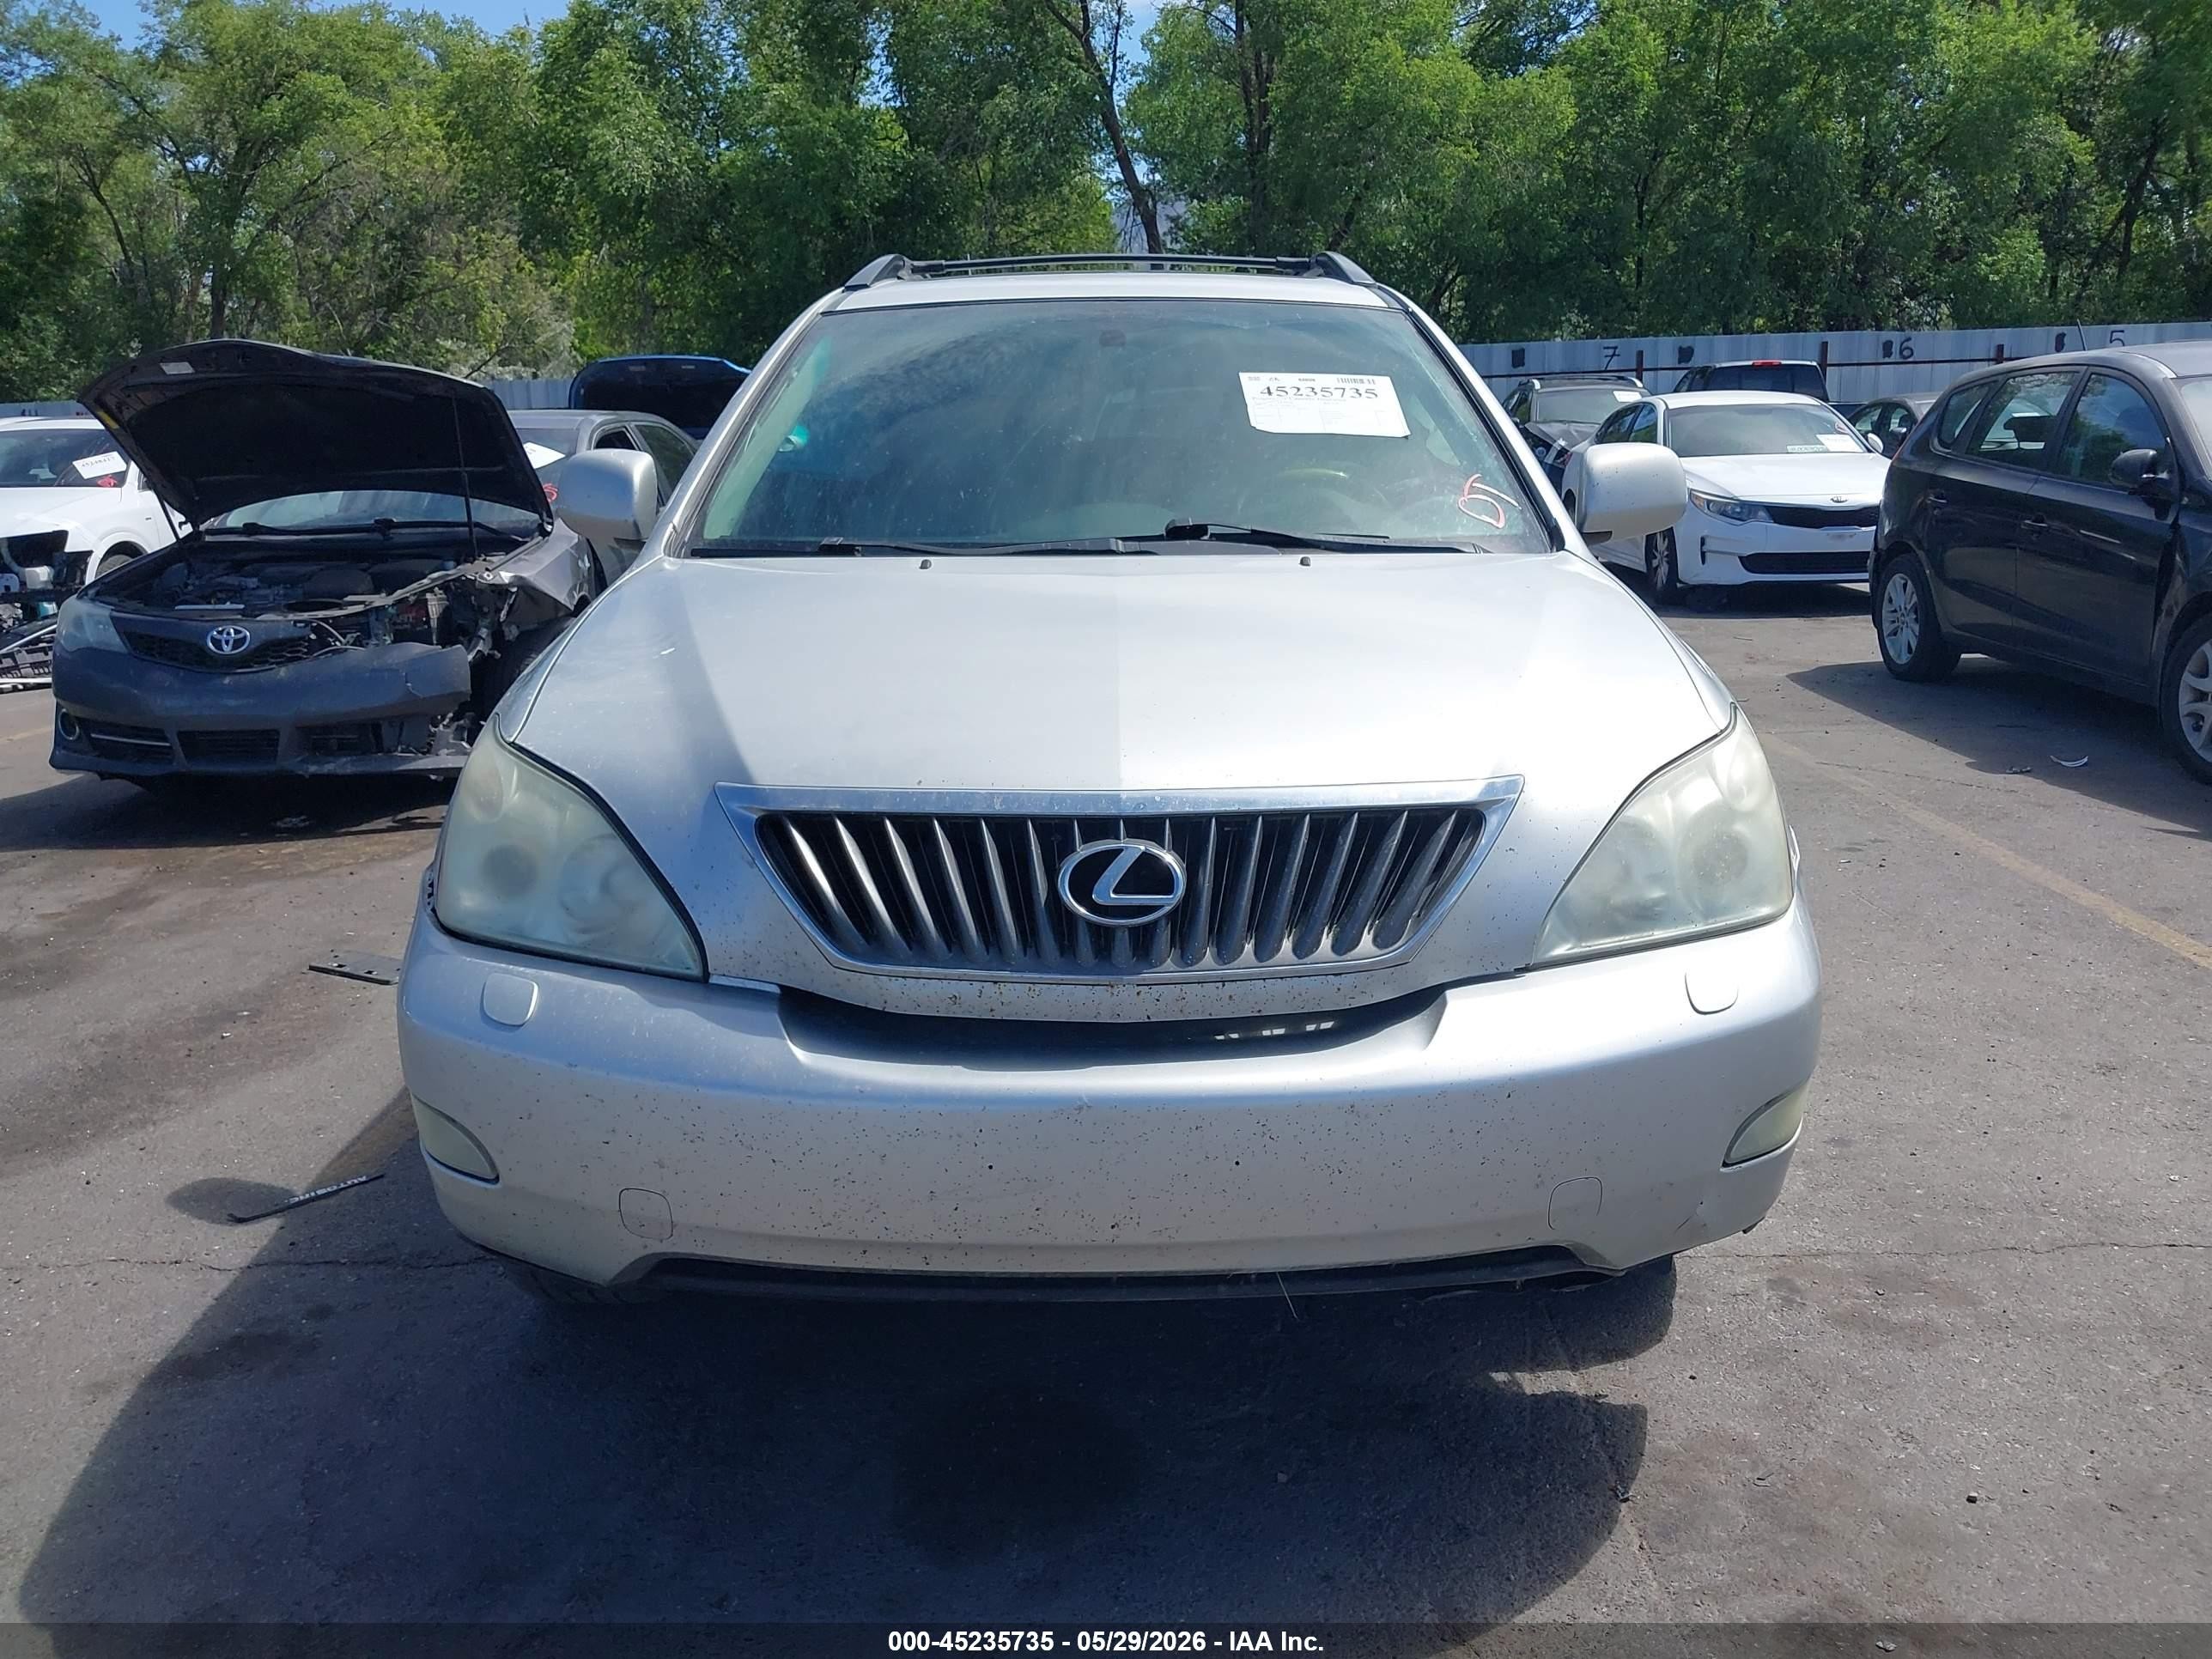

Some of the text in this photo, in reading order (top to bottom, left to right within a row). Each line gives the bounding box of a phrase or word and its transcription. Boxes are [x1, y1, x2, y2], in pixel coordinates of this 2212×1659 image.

[2109, 329, 2125, 347] 5
[1602, 346, 1620, 370] 7
[1899, 337, 1914, 360] 6
[1260, 386, 1378, 399] 45235735
